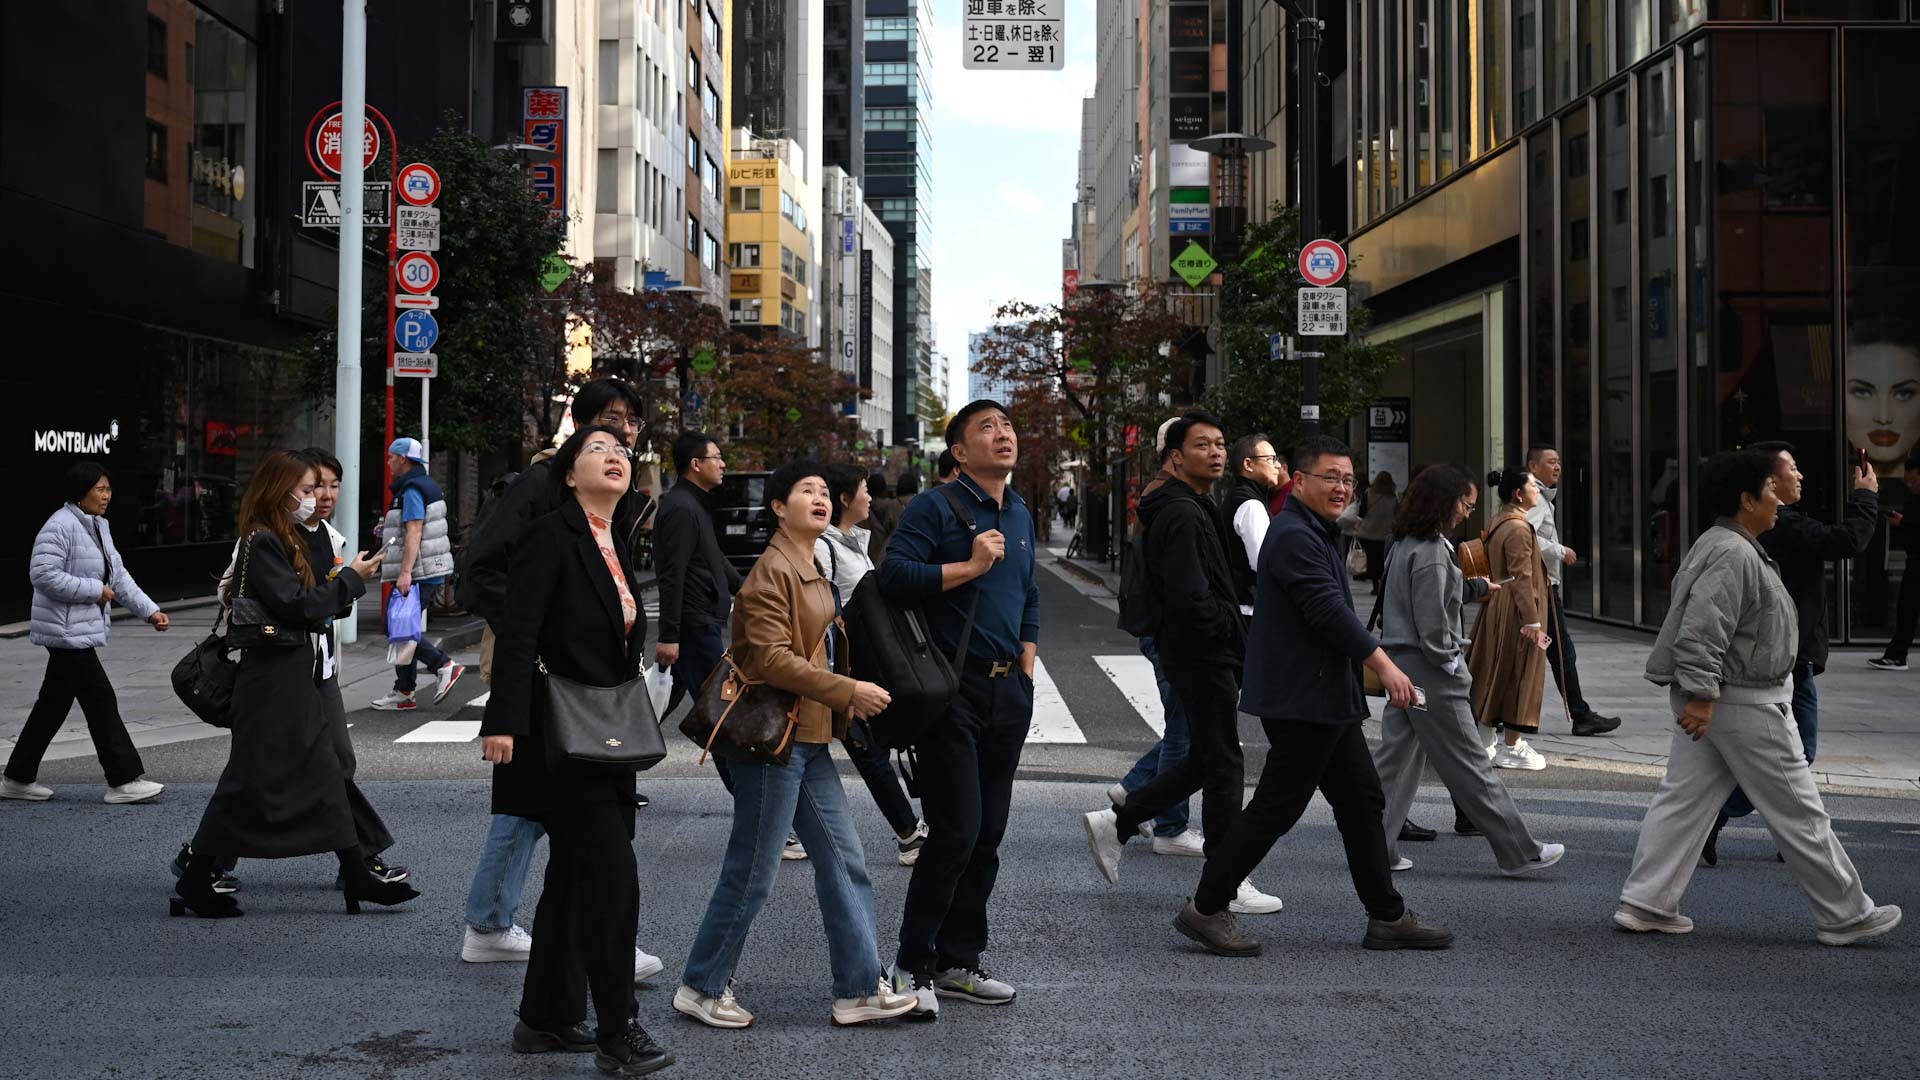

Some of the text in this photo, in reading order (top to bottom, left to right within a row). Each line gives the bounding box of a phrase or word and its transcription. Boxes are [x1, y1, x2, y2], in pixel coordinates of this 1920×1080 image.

[968, 0, 1046, 16] 迎車を除く
[973, 45, 999, 62] 22
[528, 90, 560, 116] 薬
[323, 131, 374, 155] 消栓
[1170, 207, 1209, 216] FamilyMart
[402, 238, 415, 247] 22
[406, 264, 430, 282] 30
[1302, 292, 1342, 301] 空車タクシー
[404, 320, 421, 347] P
[1302, 322, 1315, 332] 22
[415, 336, 429, 348] 60
[34, 429, 111, 455] MONTBLANC
